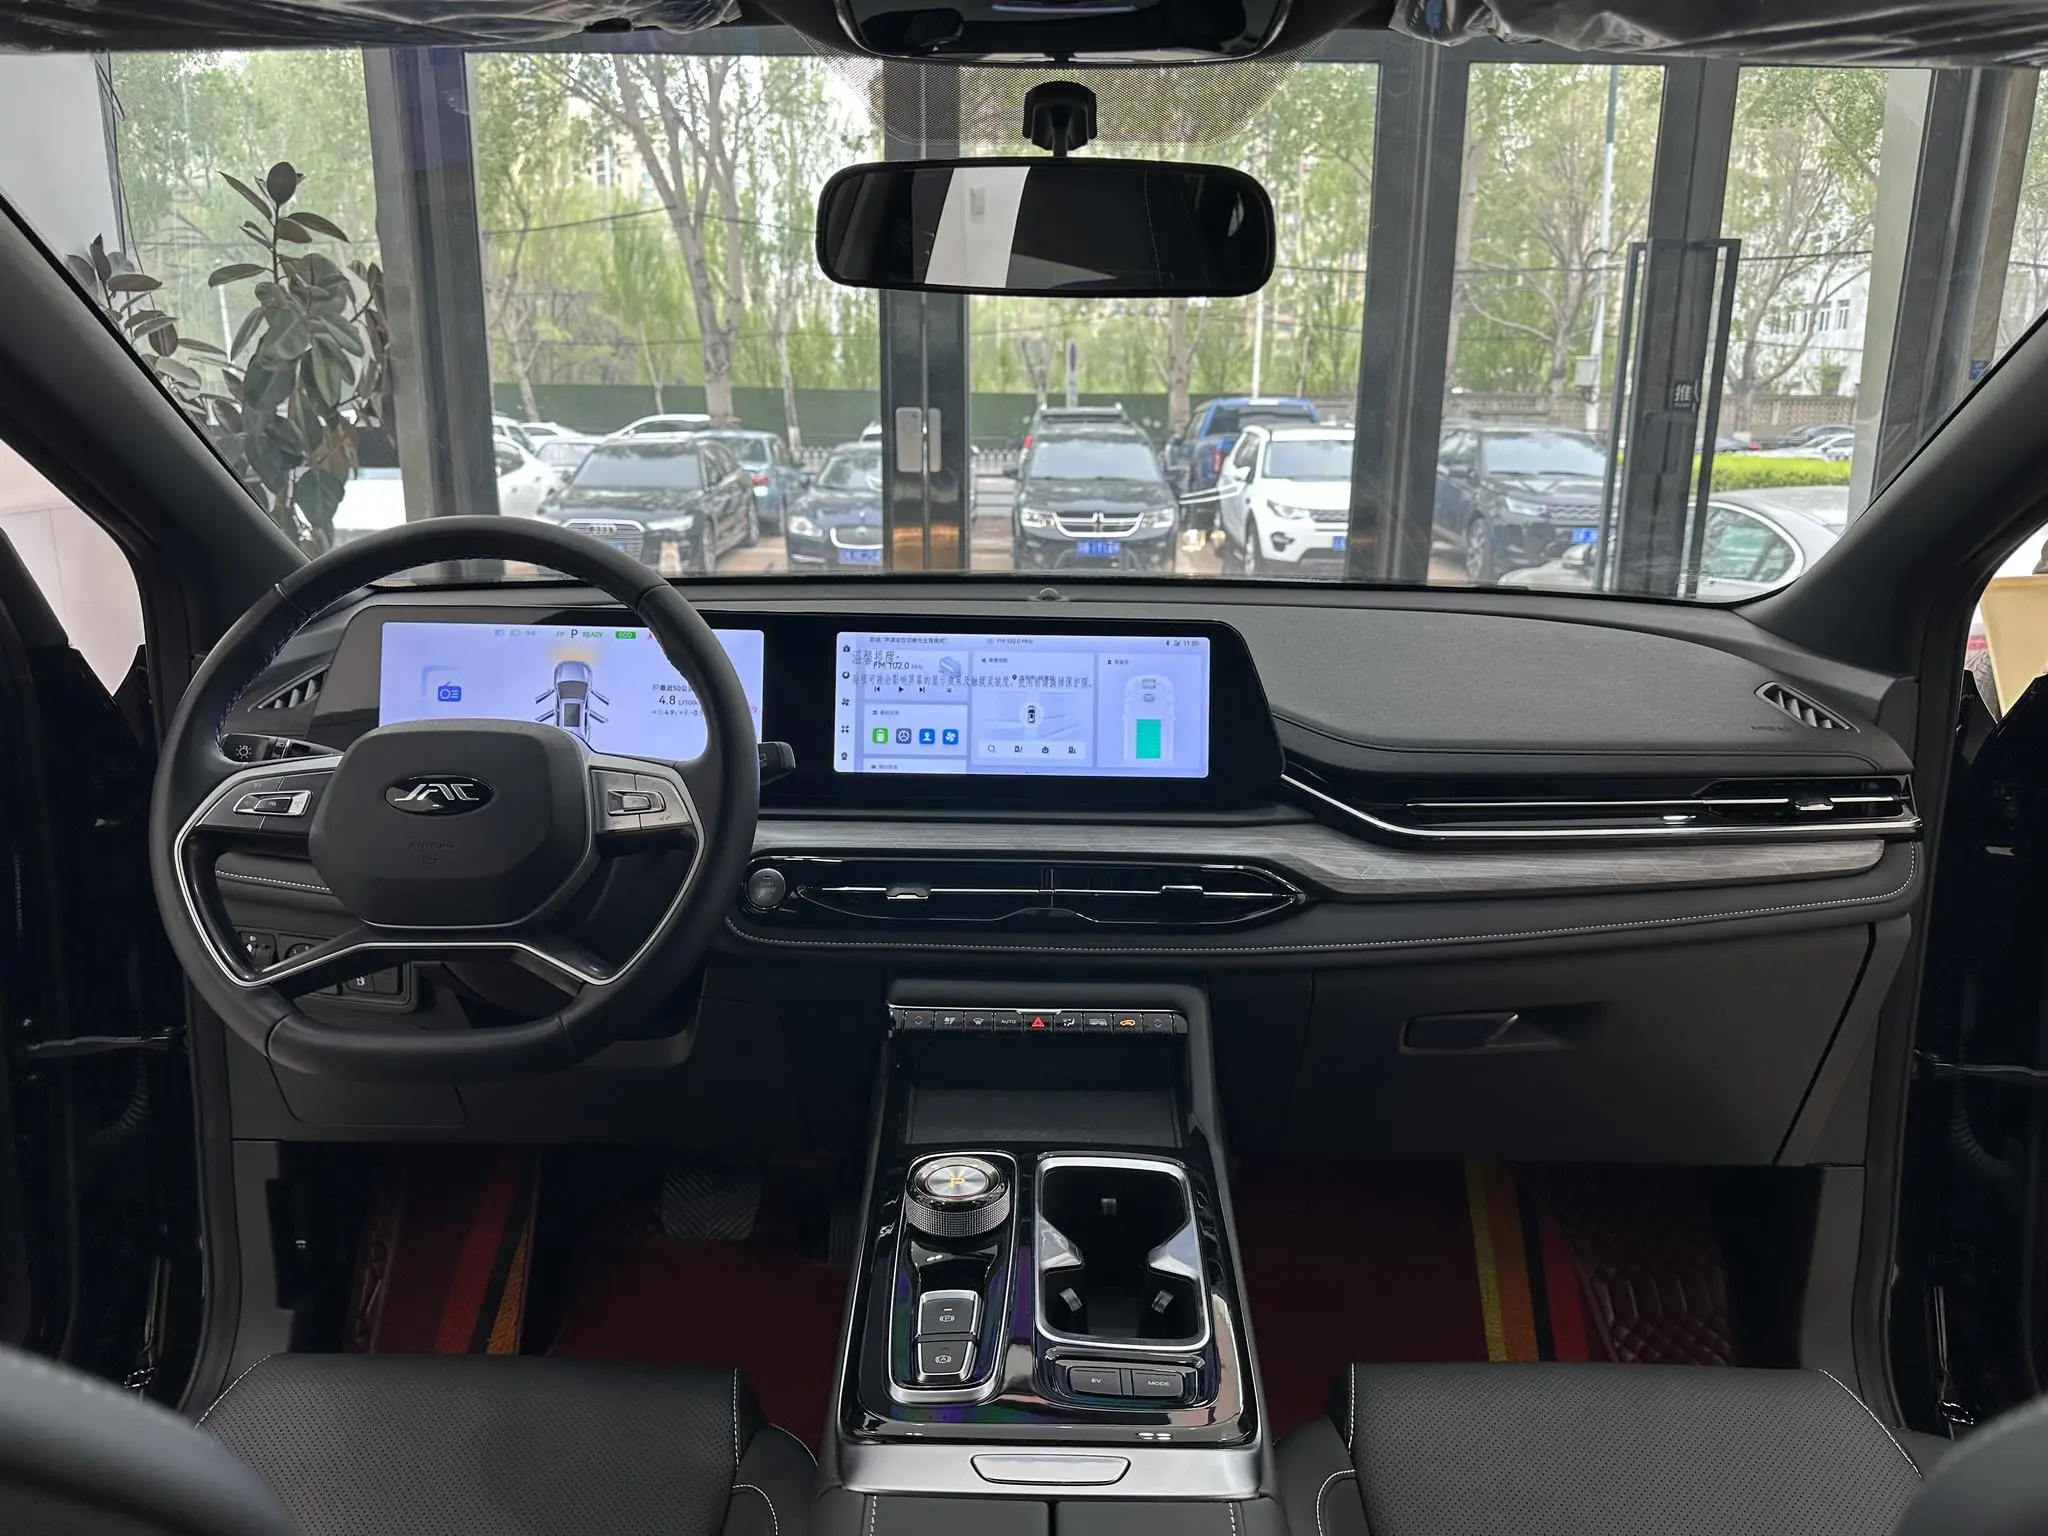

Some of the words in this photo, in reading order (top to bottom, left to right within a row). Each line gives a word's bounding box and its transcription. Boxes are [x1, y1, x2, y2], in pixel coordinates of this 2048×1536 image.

[1674, 383, 1693, 402] 推
[571, 628, 578, 639] P
[659, 695, 676, 705] 4.8
[394, 783, 479, 801] JAC
[950, 1176, 965, 1188] P
